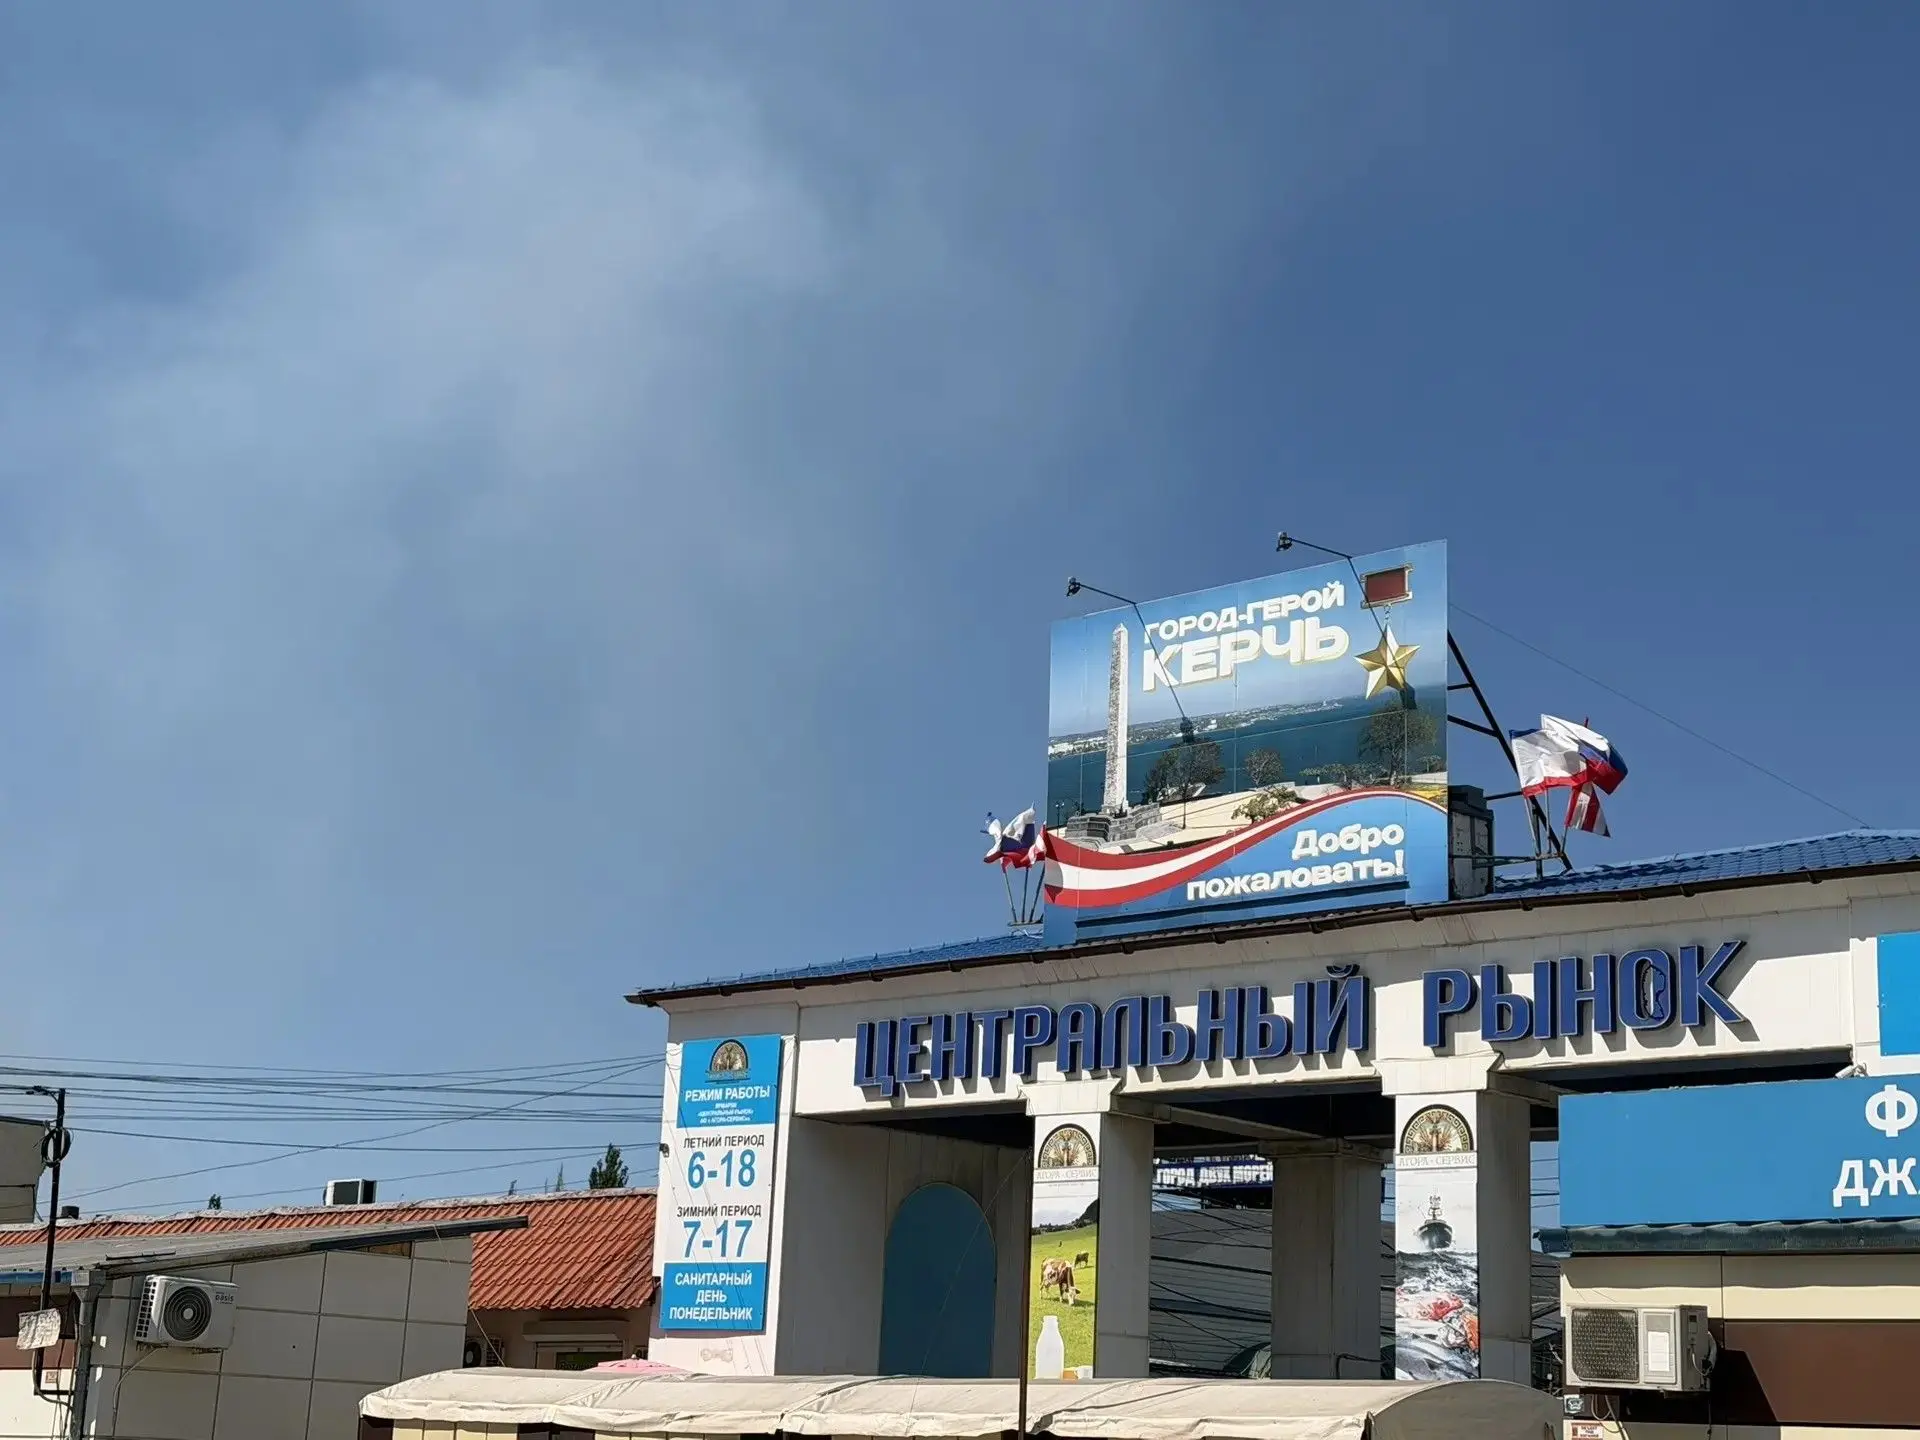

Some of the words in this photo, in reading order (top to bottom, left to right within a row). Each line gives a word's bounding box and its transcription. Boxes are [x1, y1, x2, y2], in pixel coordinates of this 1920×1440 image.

[1144, 580, 1346, 644] ГОРОД-ГЕРОЙ
[1142, 616, 1349, 692] КЕРЧЬ
[1291, 823, 1405, 860] Добро
[1186, 849, 1405, 901] пожаловать!
[854, 963, 1370, 1098] ЦЕНТРАЛЬНЫЙ
[1422, 939, 1748, 1048] РЫНОК
[685, 1087, 723, 1102] РЕЖИМ
[725, 1085, 770, 1099] РАБОТЫ
[683, 1134, 722, 1149] ЛЕТНИЙ
[724, 1134, 765, 1147] ПЕРИОД
[687, 1149, 756, 1189] 6-18
[1157, 1168, 1196, 1187] ГОРОД
[1832, 1158, 1920, 1207] ДЖ
[677, 1204, 718, 1218] ЗИМНИЙ
[720, 1205, 762, 1217] ПЕРИОД
[683, 1219, 753, 1258] 7-17
[675, 1270, 752, 1286] САНИТАРНЫЙ
[669, 1307, 753, 1322] ПОНЕДЕЛЬНИК
[696, 1290, 727, 1304] ДЕНЬ
